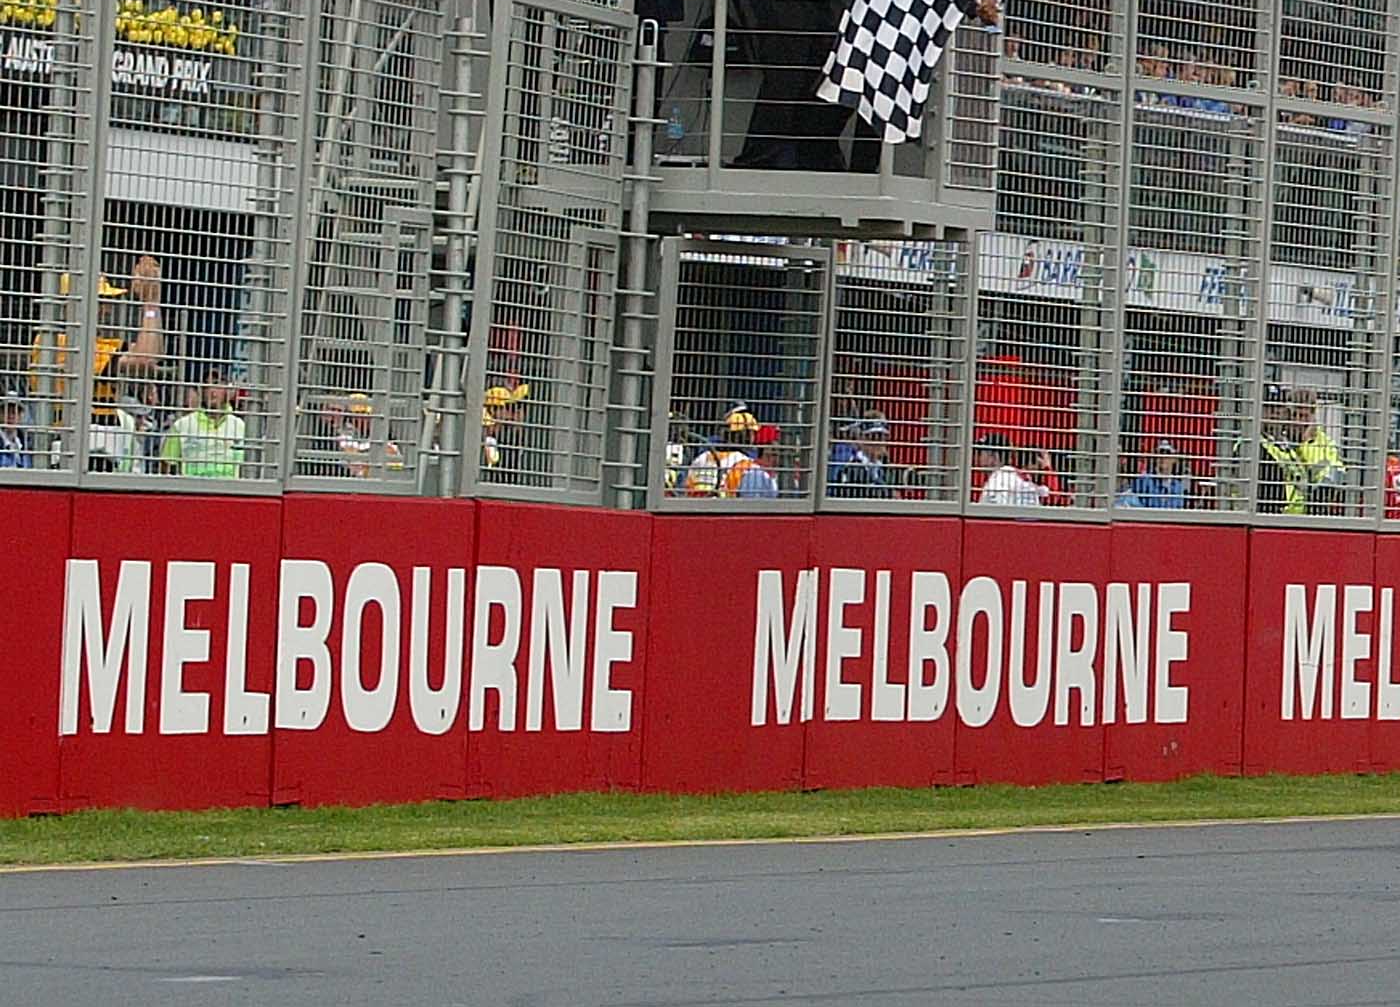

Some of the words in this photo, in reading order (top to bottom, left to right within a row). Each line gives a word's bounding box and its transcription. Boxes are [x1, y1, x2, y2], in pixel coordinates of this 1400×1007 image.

[111, 49, 169, 88] GRAND
[172, 59, 212, 94] PRIX
[59, 558, 638, 737] MELBOURNE
[751, 567, 1191, 727] MELBOURNE
